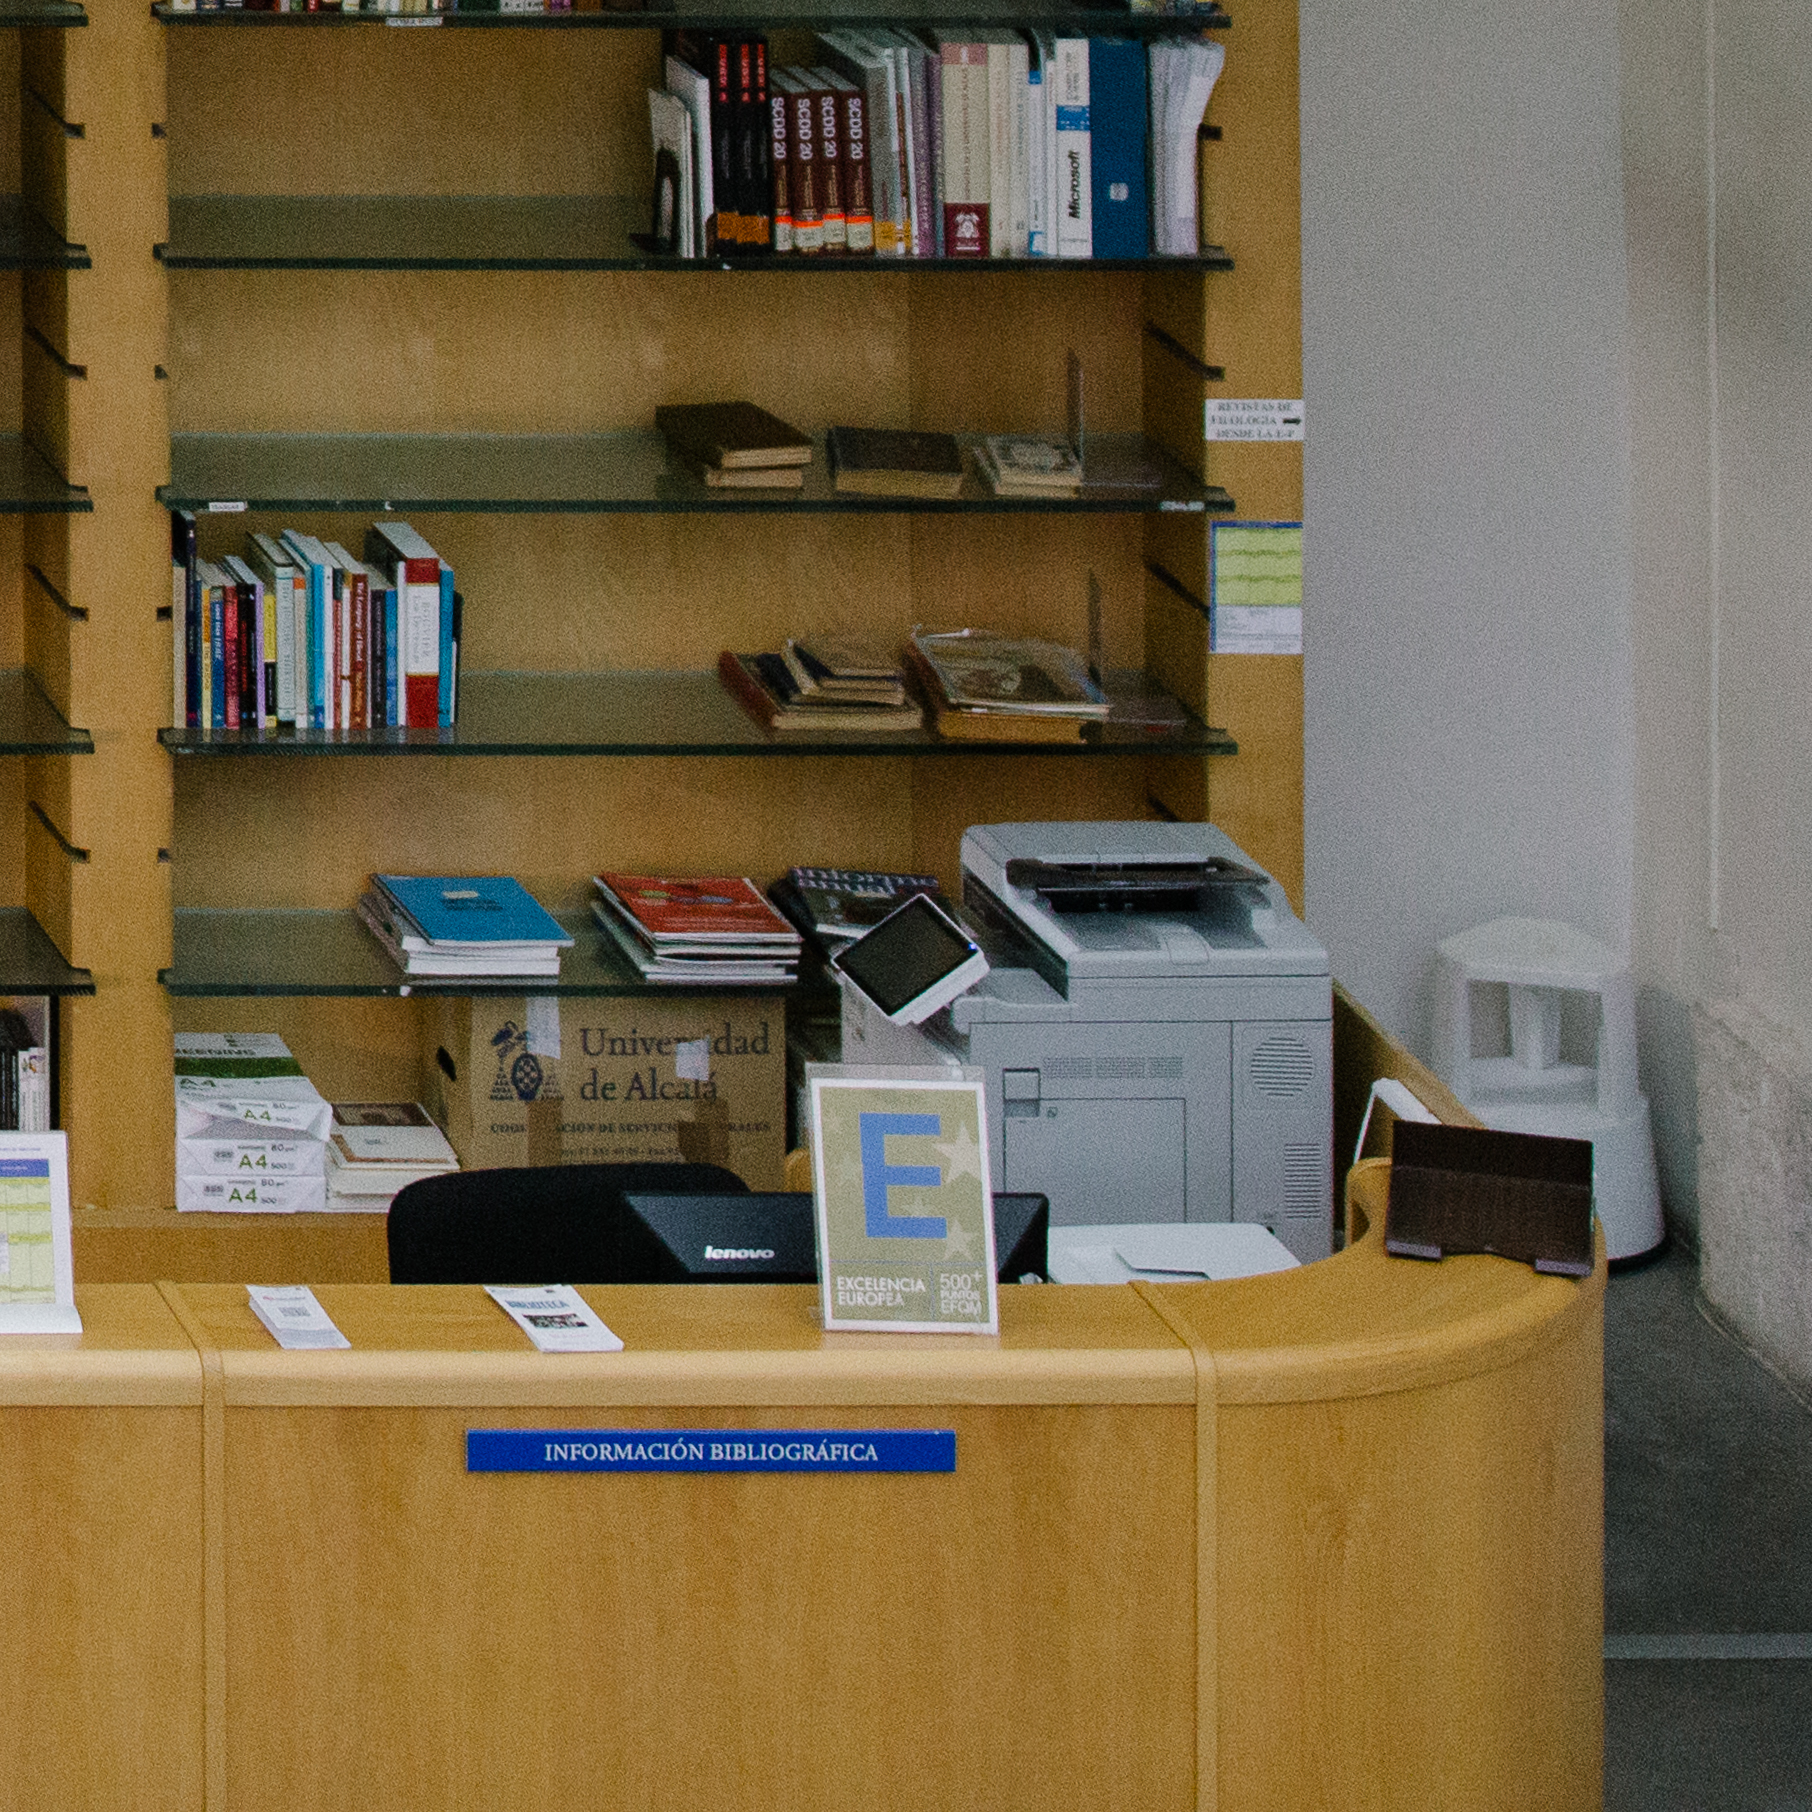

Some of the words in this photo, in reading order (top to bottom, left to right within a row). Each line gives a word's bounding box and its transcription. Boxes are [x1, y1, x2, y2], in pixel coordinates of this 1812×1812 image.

[771, 97, 785, 139] SCDD
[797, 99, 812, 139] SCDD
[821, 97, 836, 138] SCDD
[848, 98, 863, 139] SCDD
[772, 142, 786, 160] 20
[798, 142, 813, 160] 20
[822, 141, 836, 158] 20
[848, 142, 863, 160] 20
[1066, 149, 1083, 219] Microsoft
[1218, 402, 1274, 411] REVISTAS
[1277, 402, 1293, 411] DE
[1257, 428, 1272, 438] LA
[179, 1077, 216, 1088] A4
[579, 1067, 618, 1102] de
[625, 1066, 719, 1102] Alcalá
[243, 1109, 272, 1122] A4
[238, 1153, 268, 1170] A4
[859, 1112, 947, 1239] E
[228, 1187, 258, 1204] A4
[703, 1245, 775, 1260] lenovo
[836, 1276, 926, 1292] EXCELENCIA
[837, 1291, 905, 1307] EUROPEA
[940, 1290, 981, 1301] PUNTOS
[505, 1299, 570, 1310] BIBLIOTECA
[940, 1300, 983, 1315] EFQM
[544, 1437, 704, 1461] INFORMACIÓN
[709, 1439, 879, 1462] BIBLIOGRÁFICA
